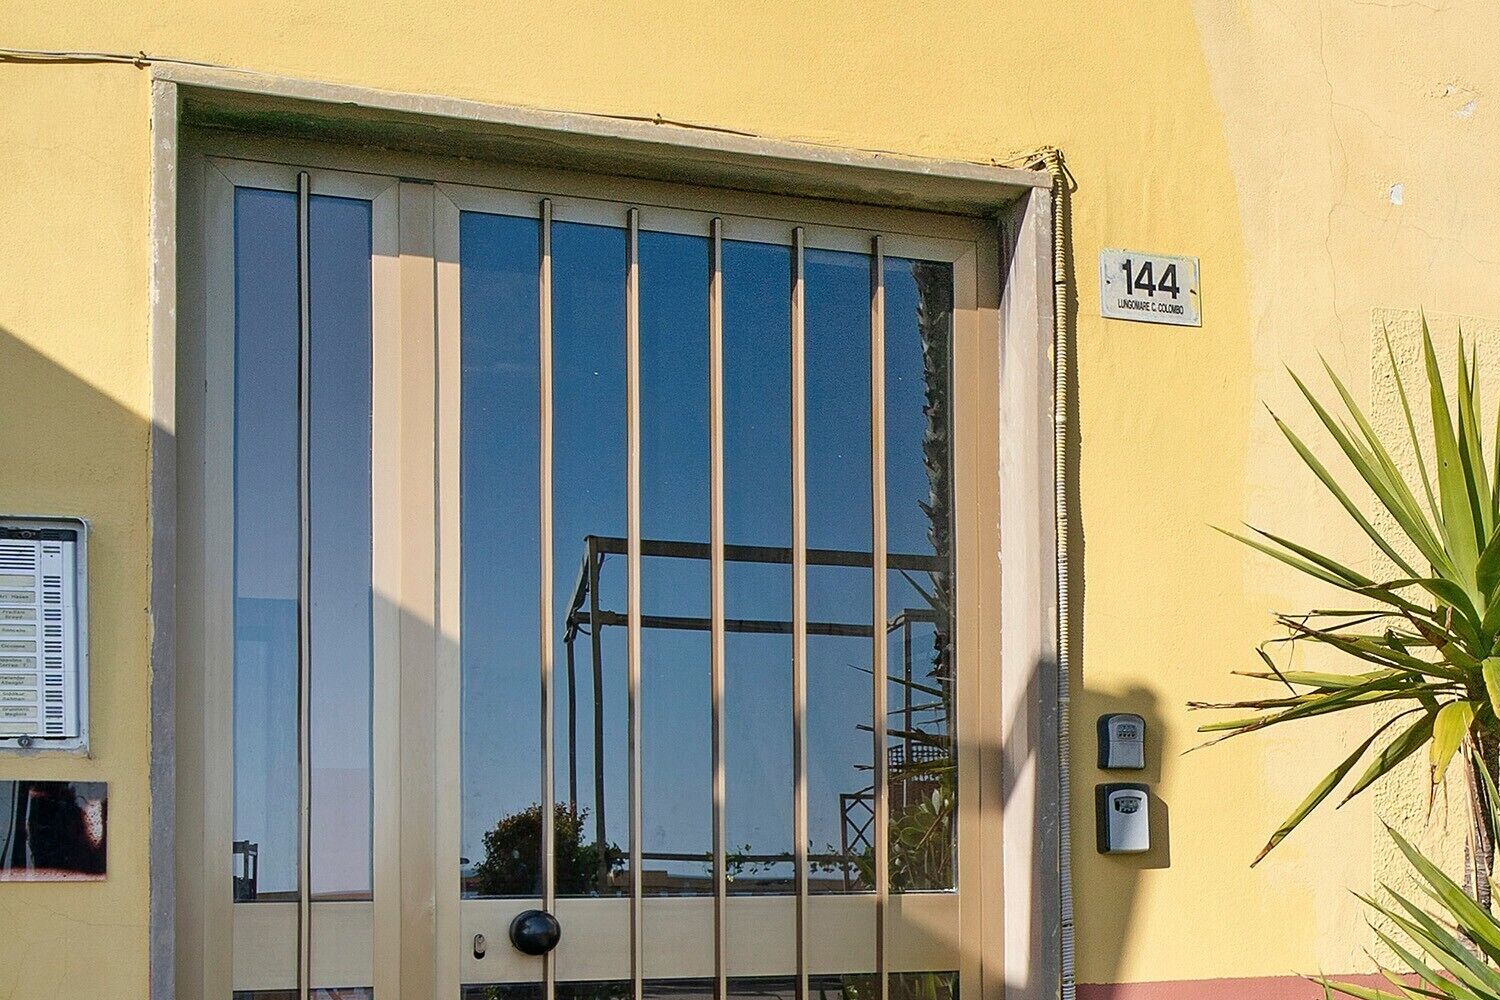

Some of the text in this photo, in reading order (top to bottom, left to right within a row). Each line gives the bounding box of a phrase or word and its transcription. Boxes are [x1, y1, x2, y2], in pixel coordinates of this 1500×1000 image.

[1121, 258, 1180, 299] 144
[1117, 298, 1184, 315] LUNGOMARE C. COLOMBO
